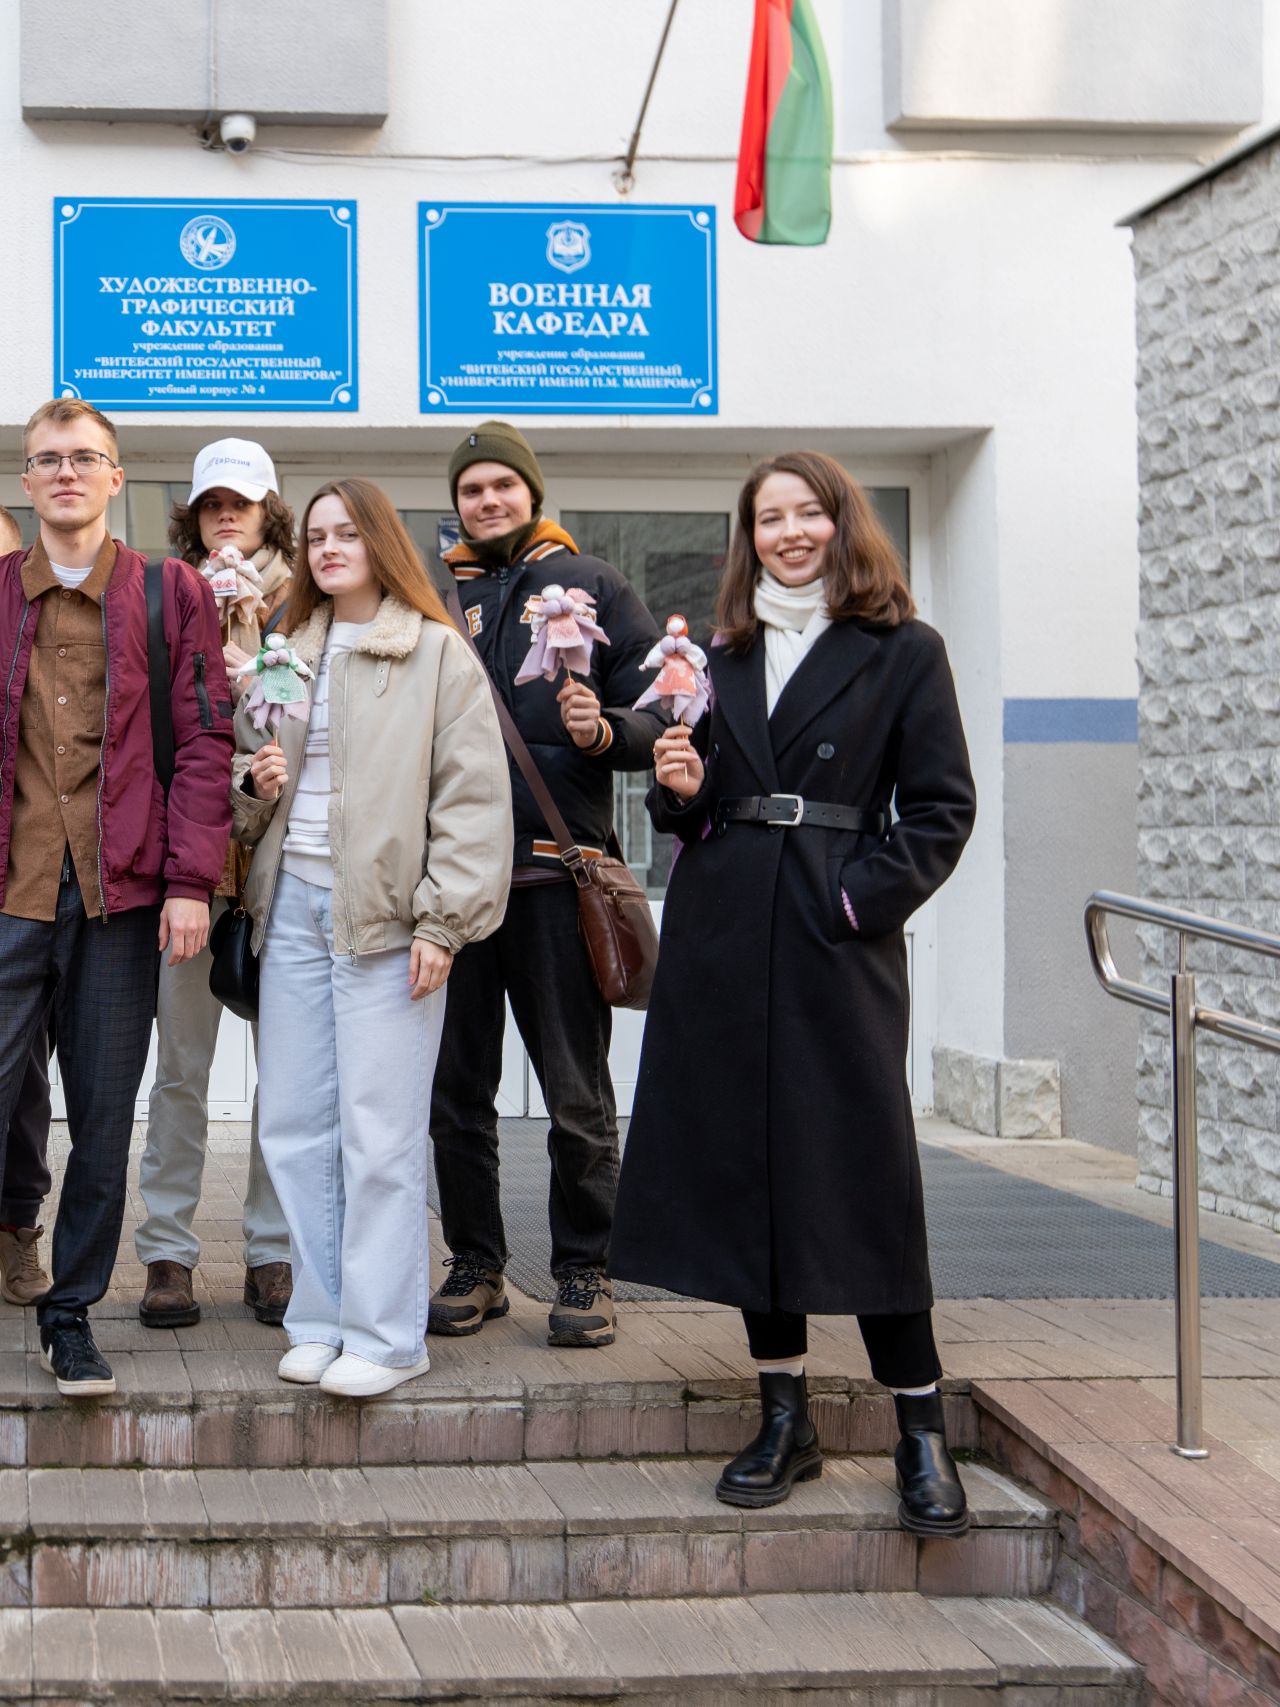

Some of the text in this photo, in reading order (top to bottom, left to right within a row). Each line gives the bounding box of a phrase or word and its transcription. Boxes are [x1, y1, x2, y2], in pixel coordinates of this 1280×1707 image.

[99, 276, 317, 295] ХУДОЖЕСТВЕННО-
[488, 282, 652, 308] ВОЕННАЯ
[121, 296, 295, 316] ГРАФИЧЕСКИЙ
[140, 319, 277, 337] ФАКУЛЬТЕТ
[492, 311, 650, 338] КАФЕДРА
[132, 340, 284, 354] учреждение образования
[497, 348, 646, 362] учреждение образования
[185, 356, 322, 369] ГОСУДАРСТВЕННЫЙ
[74, 368, 173, 380] УНИВЕРСИТЕТ
[175, 369, 227, 380] ИМЕНИ
[229, 369, 258, 380] П.М.
[549, 364, 683, 377] ГОСУДАРСТВЕННЫЙ
[440, 375, 537, 388] УНИВЕРСИТЕТ
[539, 376, 590, 388] ИМЕНИ
[592, 377, 619, 388] П.М.
[148, 383, 266, 397] учебный корпус № 4
